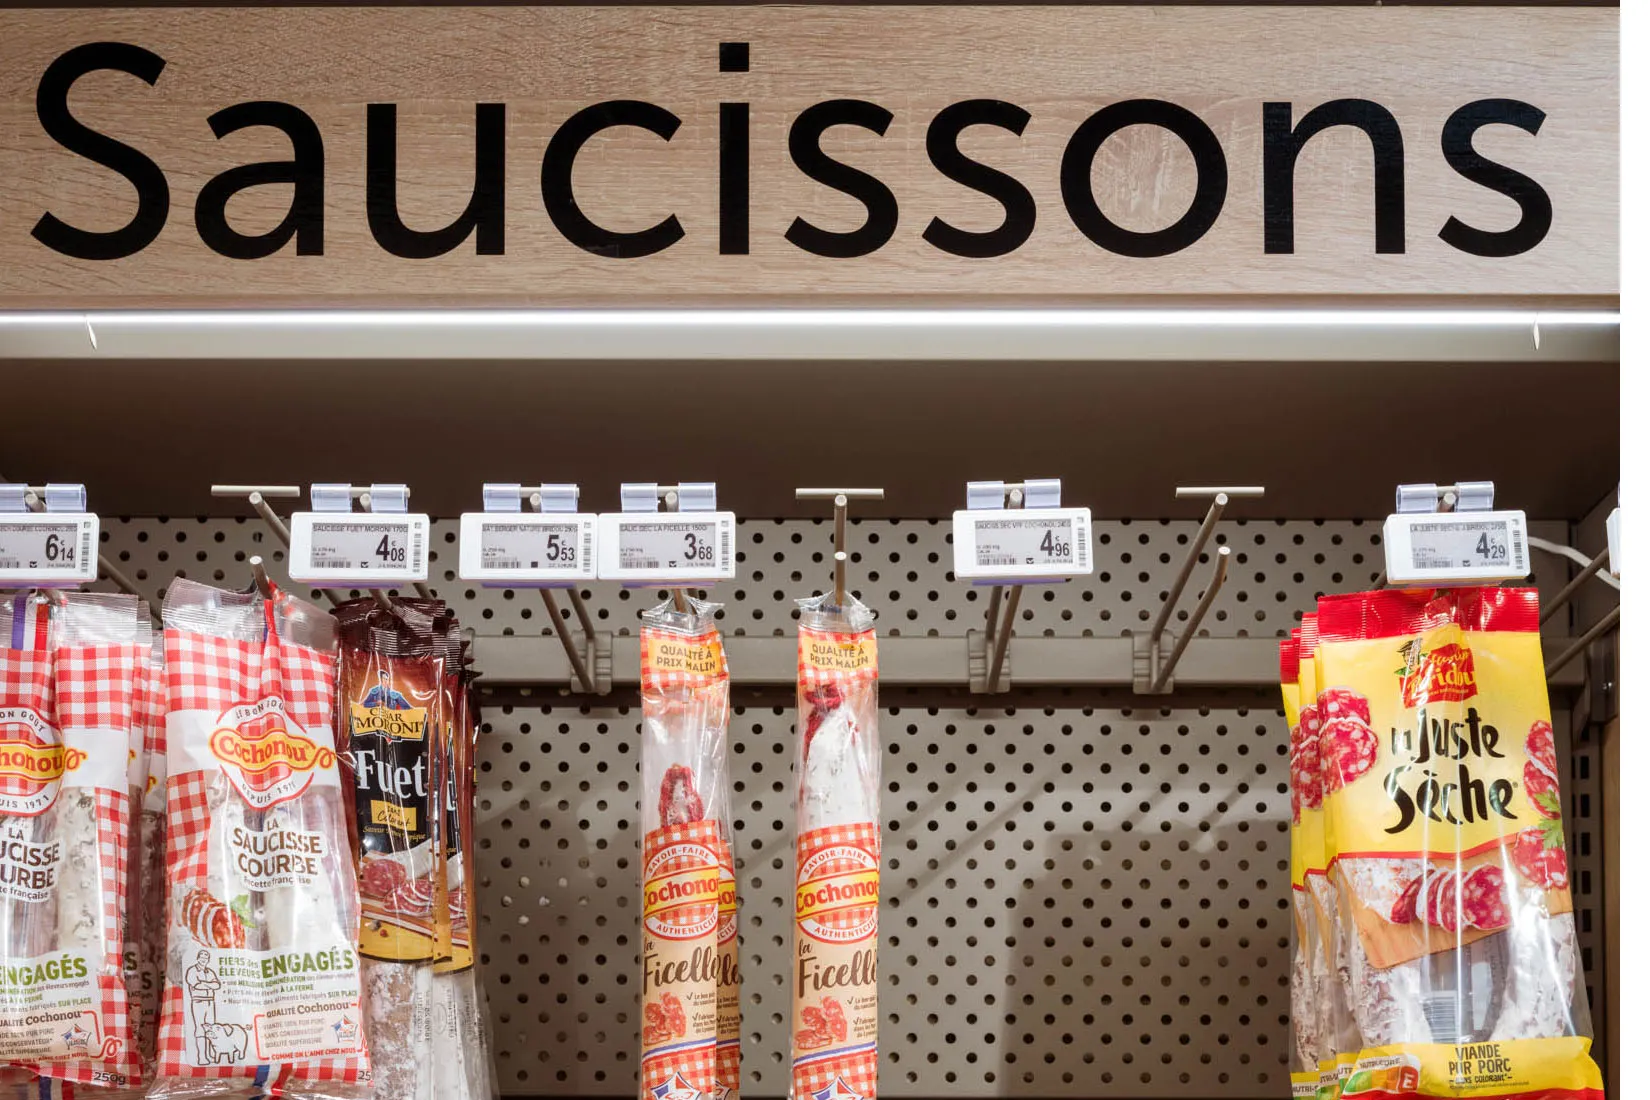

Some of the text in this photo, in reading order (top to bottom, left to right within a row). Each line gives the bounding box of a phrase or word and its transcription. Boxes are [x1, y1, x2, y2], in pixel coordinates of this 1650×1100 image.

[30, 40, 1554, 261] Saucissons
[660, 644, 704, 660] QUALITÉ
[810, 653, 869, 668] PRIX MALIN
[812, 644, 855, 658] QUALITÉ
[656, 656, 716, 672] PRIX MALIN
[1410, 707, 1506, 764] Juste
[218, 735, 308, 765] Cochonou
[0, 753, 64, 773] honou
[355, 750, 428, 800] Fuet
[1383, 763, 1519, 834] Sèche
[8, 827, 24, 841] LA
[266, 820, 279, 831] LA
[233, 827, 321, 855] SAUCISSE
[0, 842, 60, 867] CISSE
[648, 846, 710, 874] SAVOIR-FAIRE
[237, 854, 319, 877] COURBE
[0, 863, 54, 890] URBE
[644, 878, 718, 911] ochono
[815, 917, 875, 939] AUTHENTICIT
[798, 939, 812, 957] la
[261, 946, 354, 979] ENGAGÉS
[25, 1010, 84, 1026] Cochonou
[296, 1003, 350, 1015] Cochonou
[1455, 1044, 1502, 1060] VIANDE
[1448, 1057, 1512, 1075] PUR PORC
[94, 1071, 126, 1085] 250g
